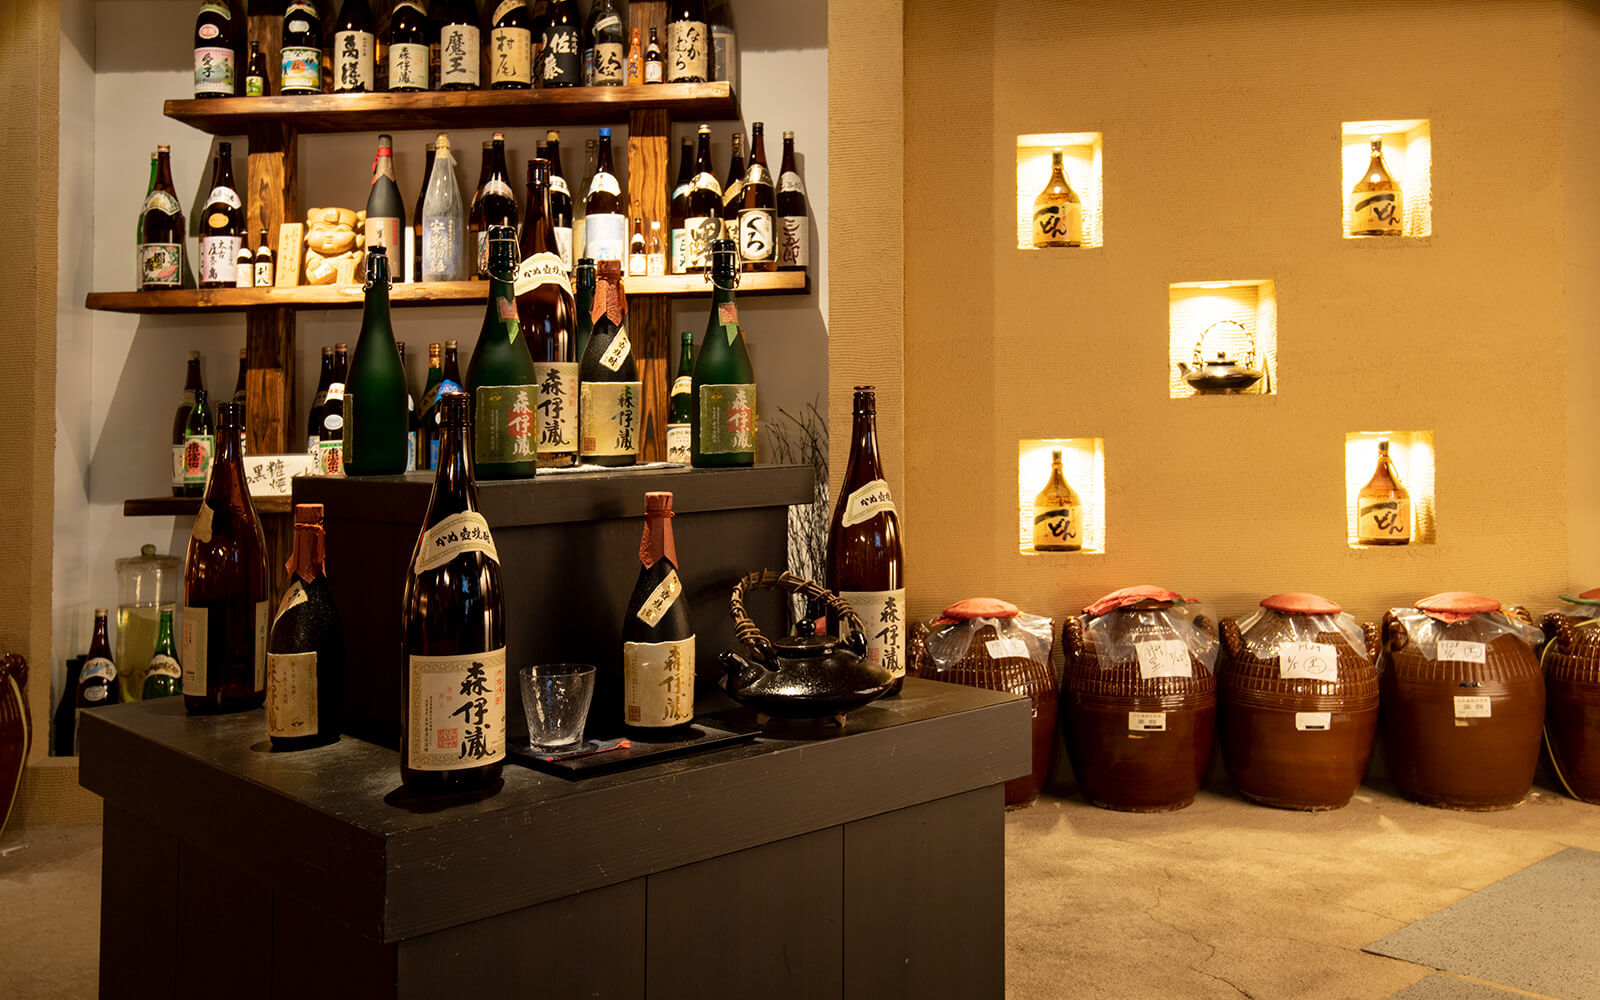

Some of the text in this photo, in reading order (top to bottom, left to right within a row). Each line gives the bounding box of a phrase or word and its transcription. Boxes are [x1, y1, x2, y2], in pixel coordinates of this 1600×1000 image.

[445, 30, 467, 76] 魔王
[495, 30, 516, 77] 村尾
[745, 215, 766, 253] くろ
[781, 217, 800, 265] 三五郎
[507, 390, 535, 456] 森伊蔵
[536, 367, 570, 446] 森伊蔵
[611, 385, 635, 451] 森伊蔵
[727, 390, 752, 449] 森伊蔵
[873, 596, 902, 674] 森伊蔵
[448, 661, 497, 760] 森伊蔵
[658, 646, 687, 721] 森伊蔵
